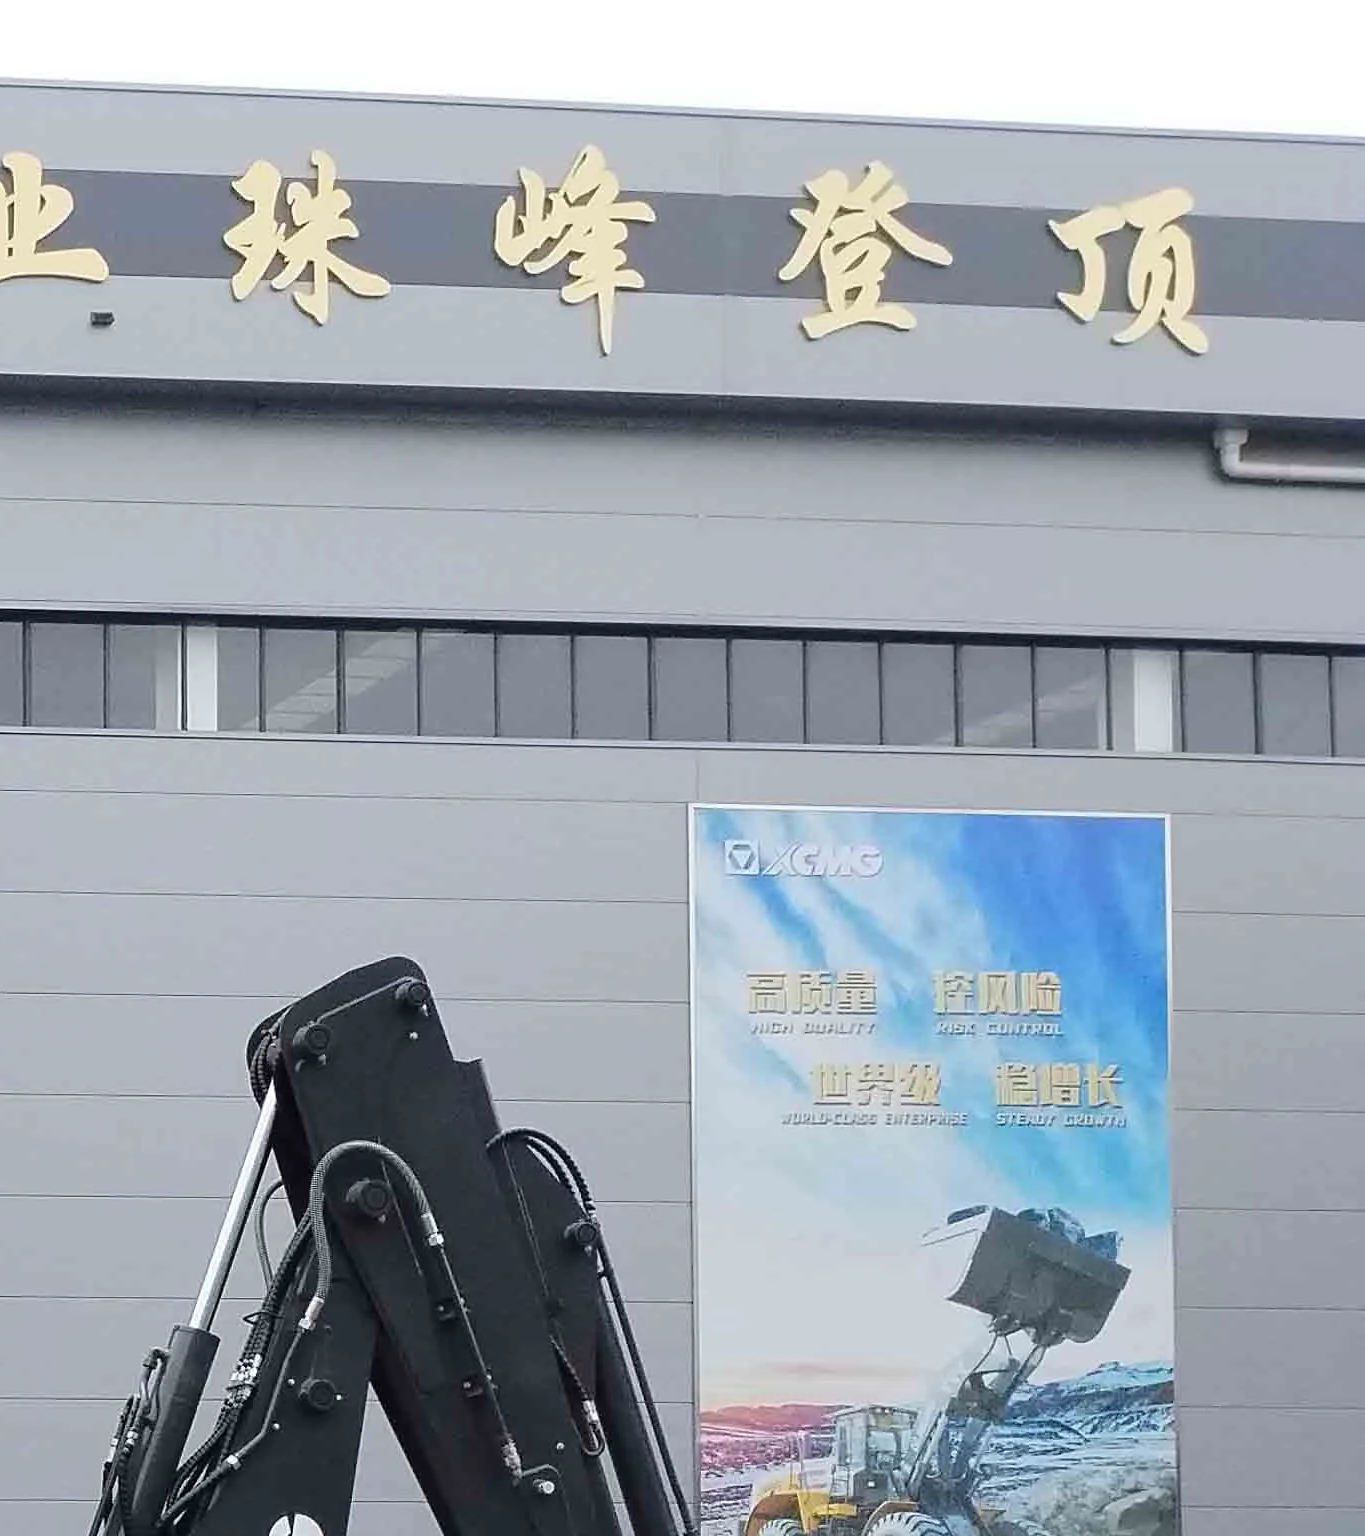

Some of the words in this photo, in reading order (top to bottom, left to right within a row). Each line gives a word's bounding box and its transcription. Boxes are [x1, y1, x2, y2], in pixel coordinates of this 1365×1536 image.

[761, 840, 885, 879] XCMG
[746, 971, 878, 1016] 高质量
[932, 969, 1063, 1017] 控风险
[803, 1022, 877, 1035] QUALITY
[935, 1021, 977, 1036] RISK
[986, 1022, 1065, 1037] CONTROL
[810, 1061, 942, 1107] 世界级
[884, 1112, 969, 1127] ENTERPRISE
[995, 1111, 1057, 1127] STEADY
[1063, 1113, 1129, 1129] GROWTH
